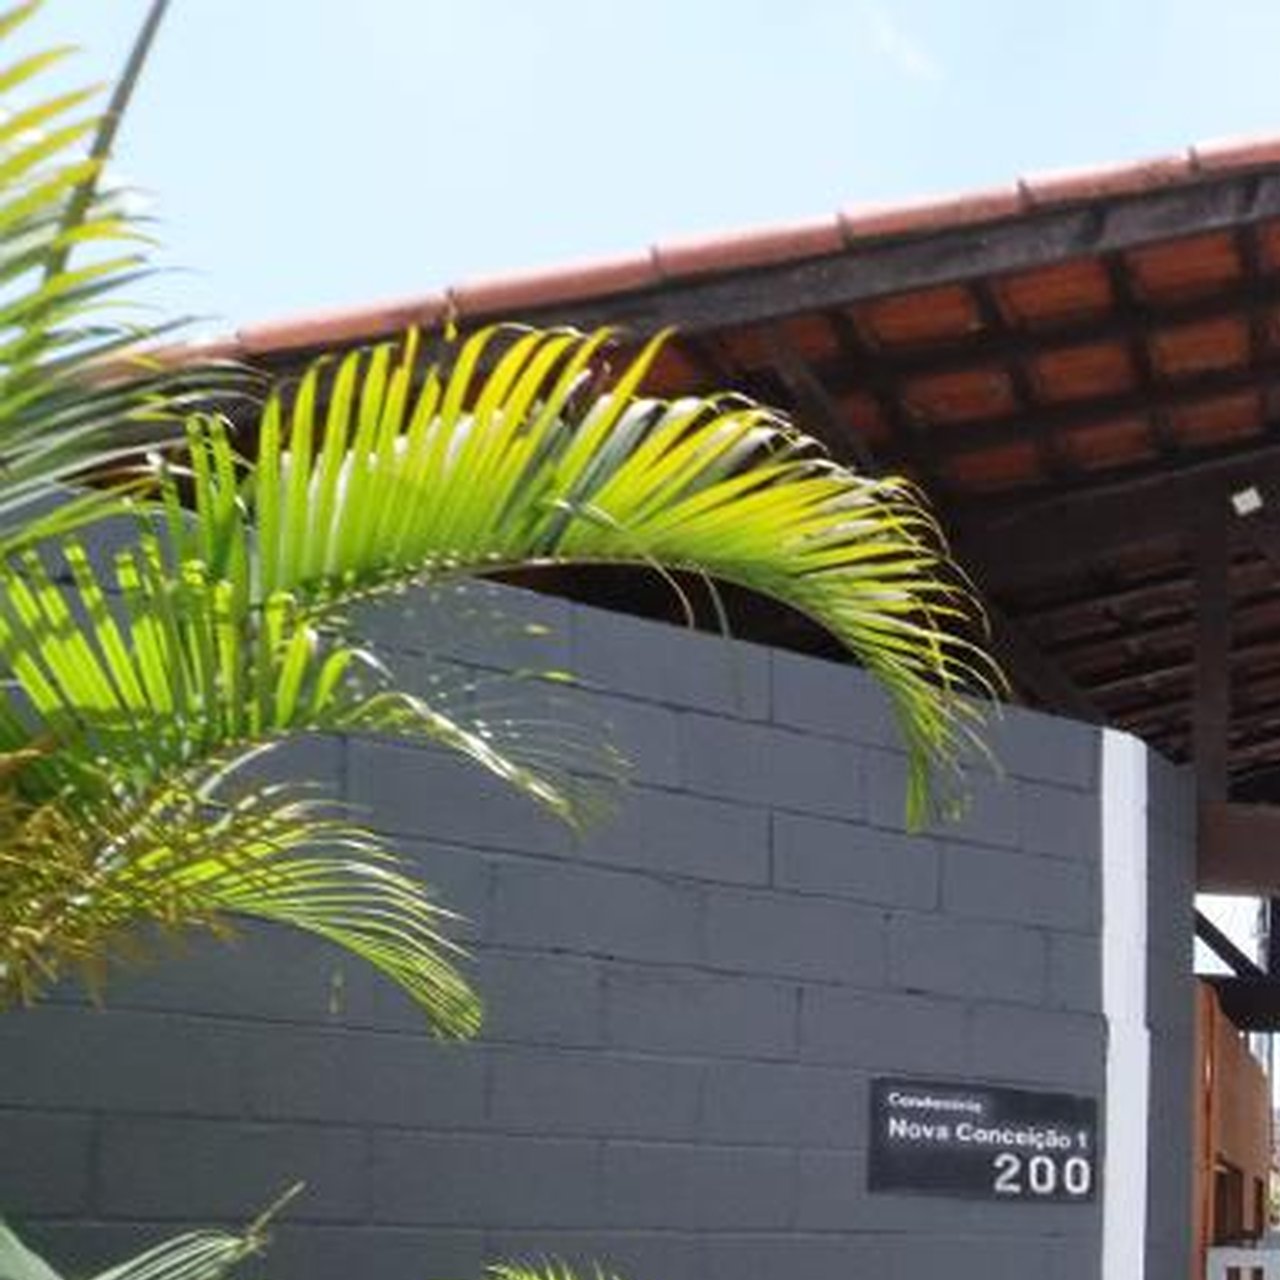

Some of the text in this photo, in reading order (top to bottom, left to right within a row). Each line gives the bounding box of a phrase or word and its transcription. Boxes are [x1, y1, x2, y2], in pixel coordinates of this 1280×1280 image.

[889, 1118, 949, 1140] Nova
[956, 1122, 1071, 1150] Conceição
[994, 1153, 1091, 1194] 200
